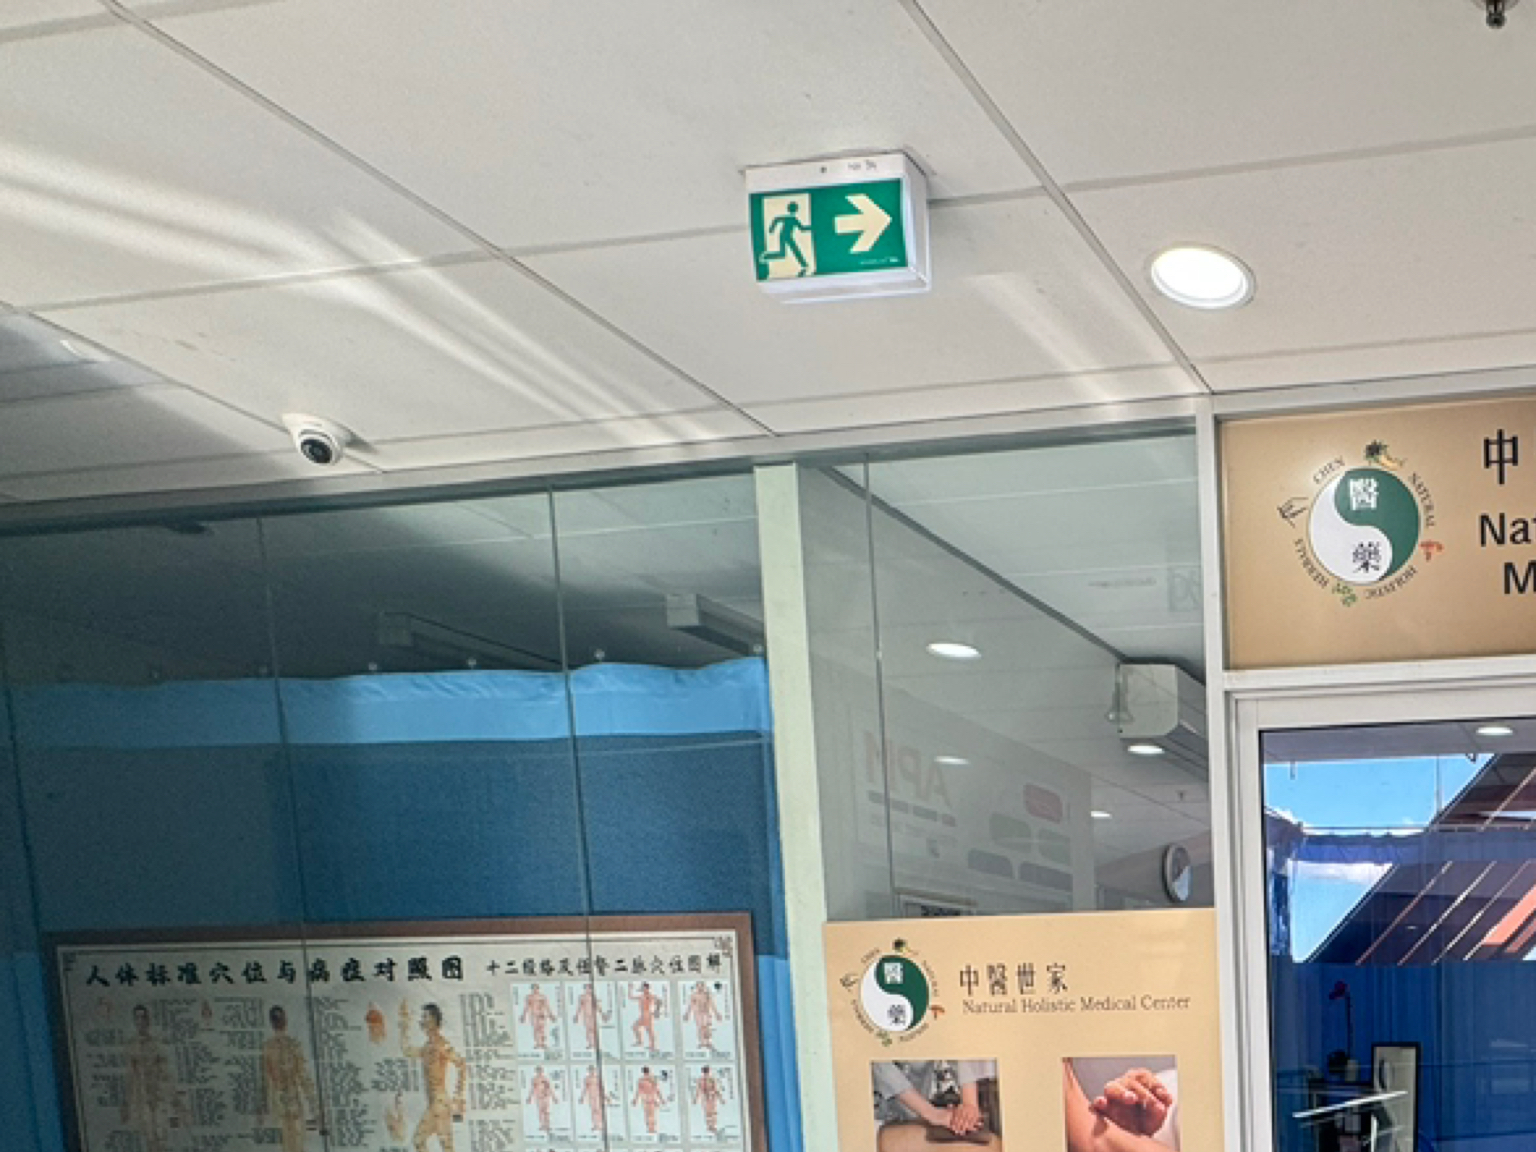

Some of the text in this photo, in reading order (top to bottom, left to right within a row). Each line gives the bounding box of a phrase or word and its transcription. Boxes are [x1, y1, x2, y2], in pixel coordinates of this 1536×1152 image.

[959, 963, 1068, 997] 中醫世家
[962, 995, 1191, 1014] Natural Holistic Medical Center
